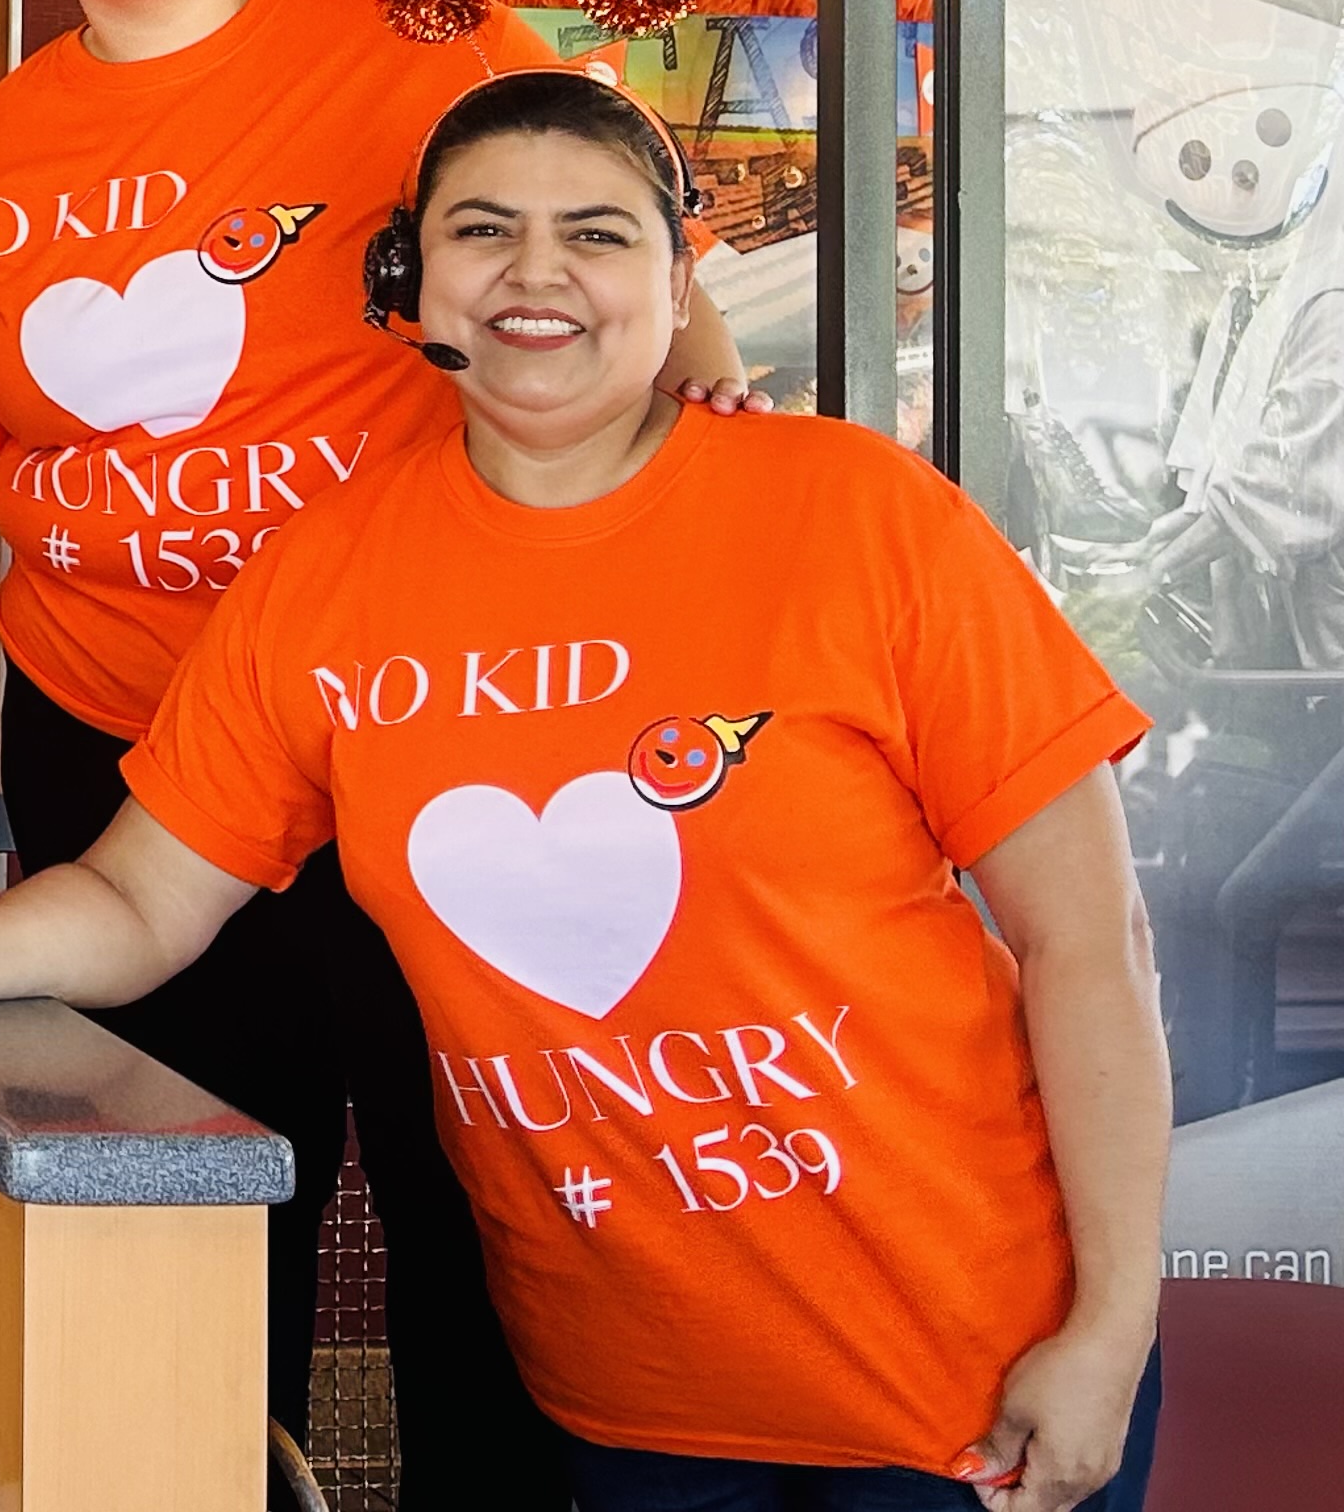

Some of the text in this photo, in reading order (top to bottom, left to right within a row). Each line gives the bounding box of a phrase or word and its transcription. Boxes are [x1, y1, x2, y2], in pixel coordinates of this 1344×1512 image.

[51, 169, 188, 243] KID
[11, 430, 370, 517] HUNGRY
[40, 523, 81, 574] #
[307, 637, 631, 732] NO KID
[432, 1003, 861, 1133] HUNGRY
[553, 1122, 842, 1229] # 1539
[1245, 1249, 1331, 1286] can
